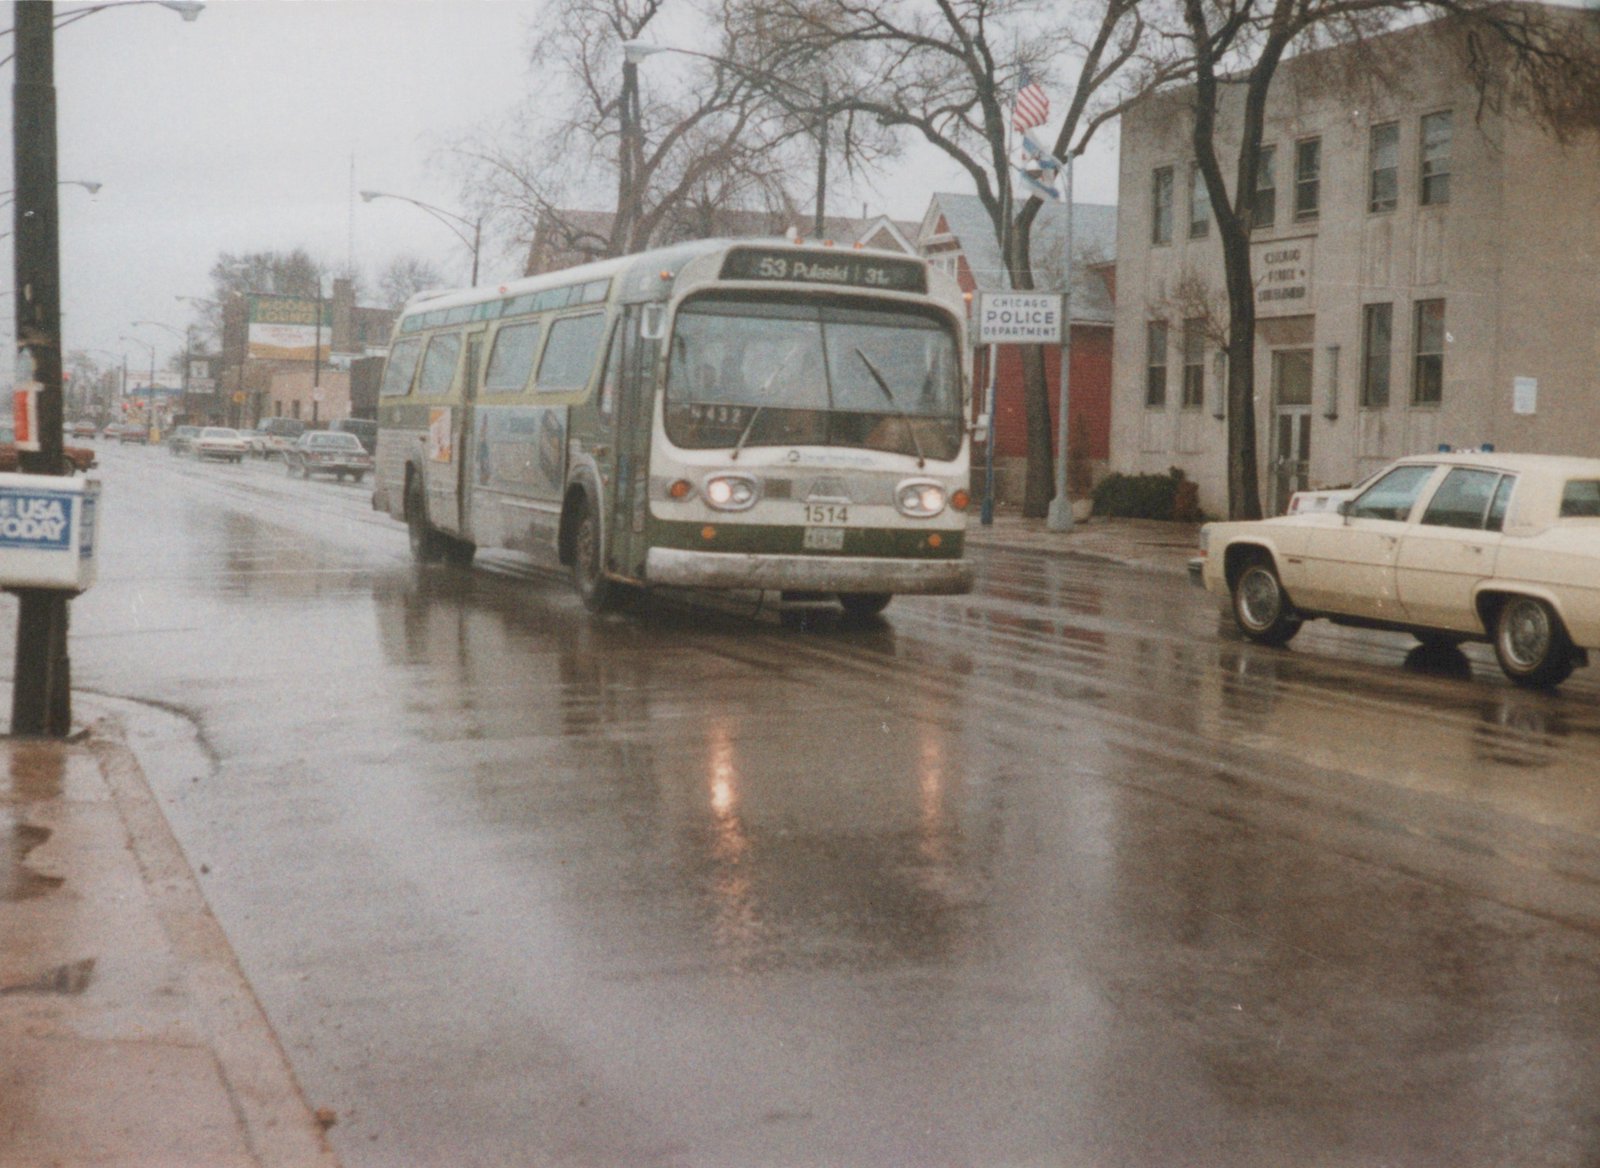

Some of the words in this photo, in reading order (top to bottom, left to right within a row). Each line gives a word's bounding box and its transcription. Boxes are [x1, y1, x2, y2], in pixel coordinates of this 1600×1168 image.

[759, 257, 787, 278] 53
[792, 262, 848, 282] Pulaski
[992, 299, 1048, 308] CHICAGO
[986, 310, 1055, 324] POLICE
[983, 326, 1056, 336] DEPARTMENT
[17, 498, 65, 520] USA
[804, 505, 848, 523] 1514
[0, 517, 66, 541] ODAY
